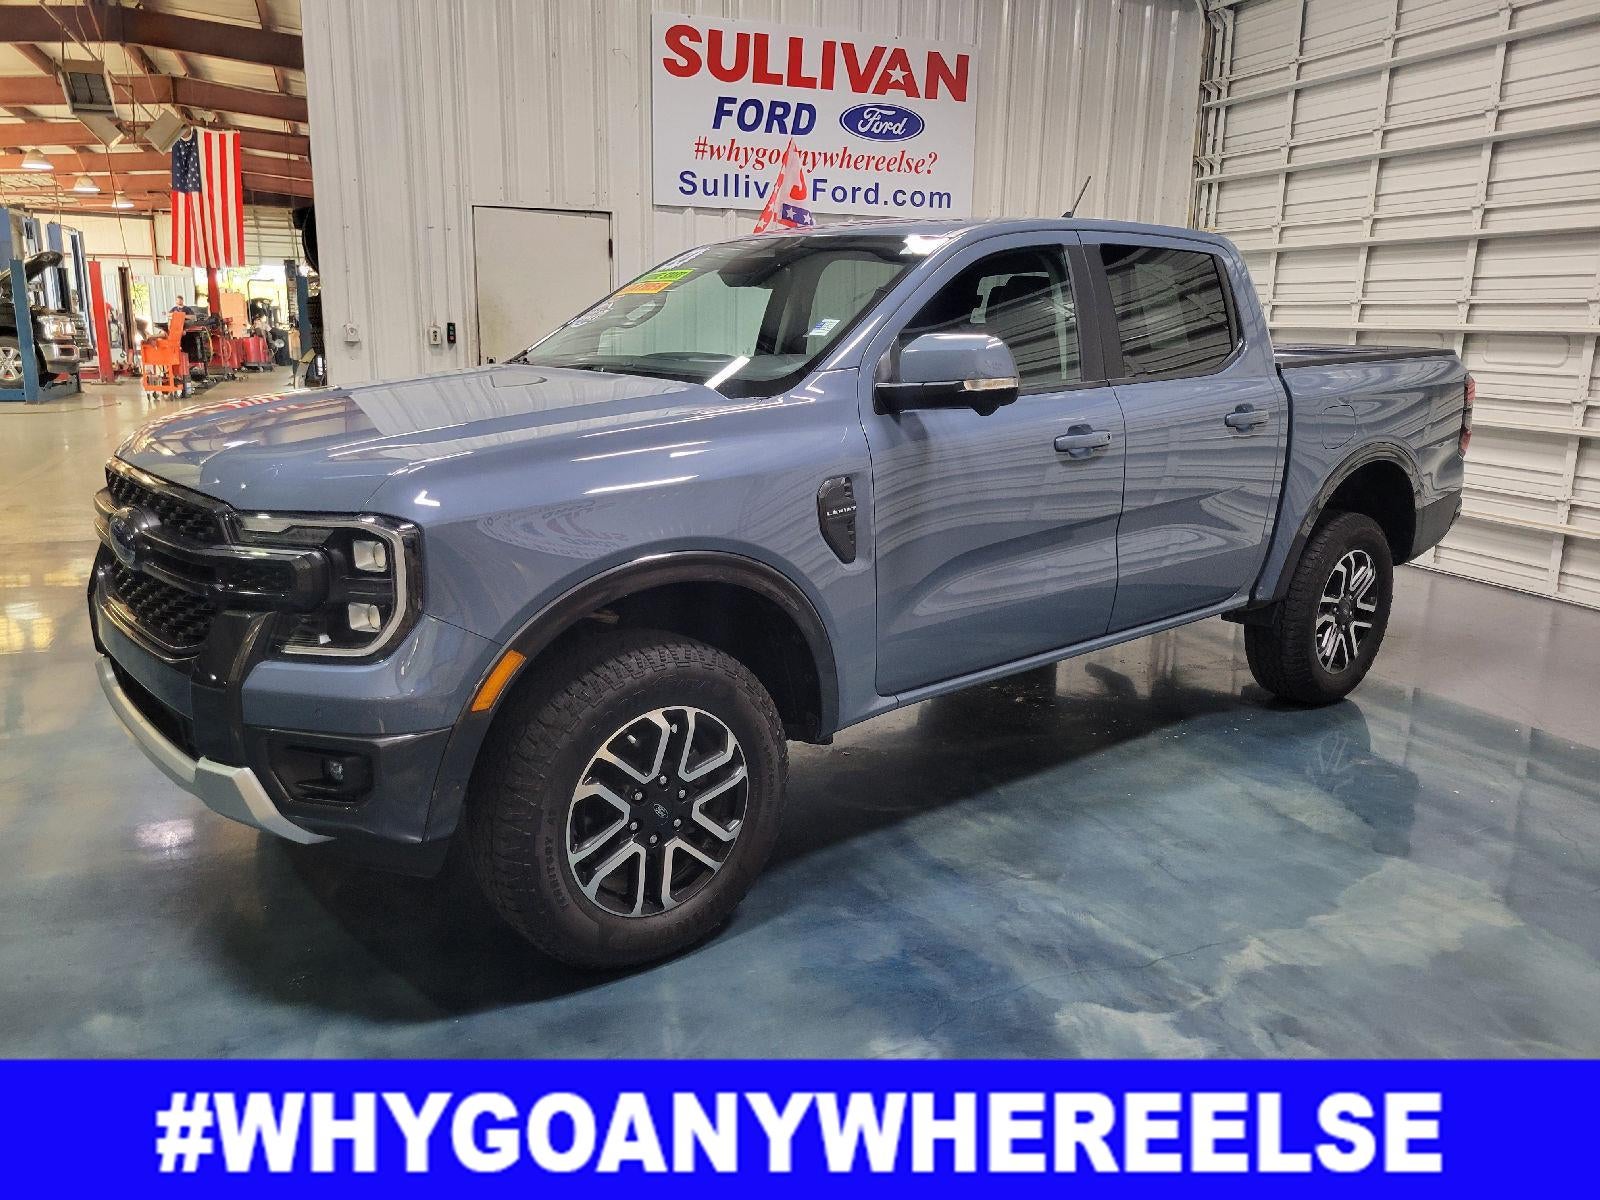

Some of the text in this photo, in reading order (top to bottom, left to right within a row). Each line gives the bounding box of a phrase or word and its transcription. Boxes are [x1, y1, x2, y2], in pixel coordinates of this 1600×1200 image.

[662, 24, 969, 102] SULLIVAN
[712, 96, 817, 136] FORD
[857, 107, 908, 135] Ford
[694, 136, 938, 175] #whygonywhereelse?
[678, 170, 952, 209] SullivFord.com
